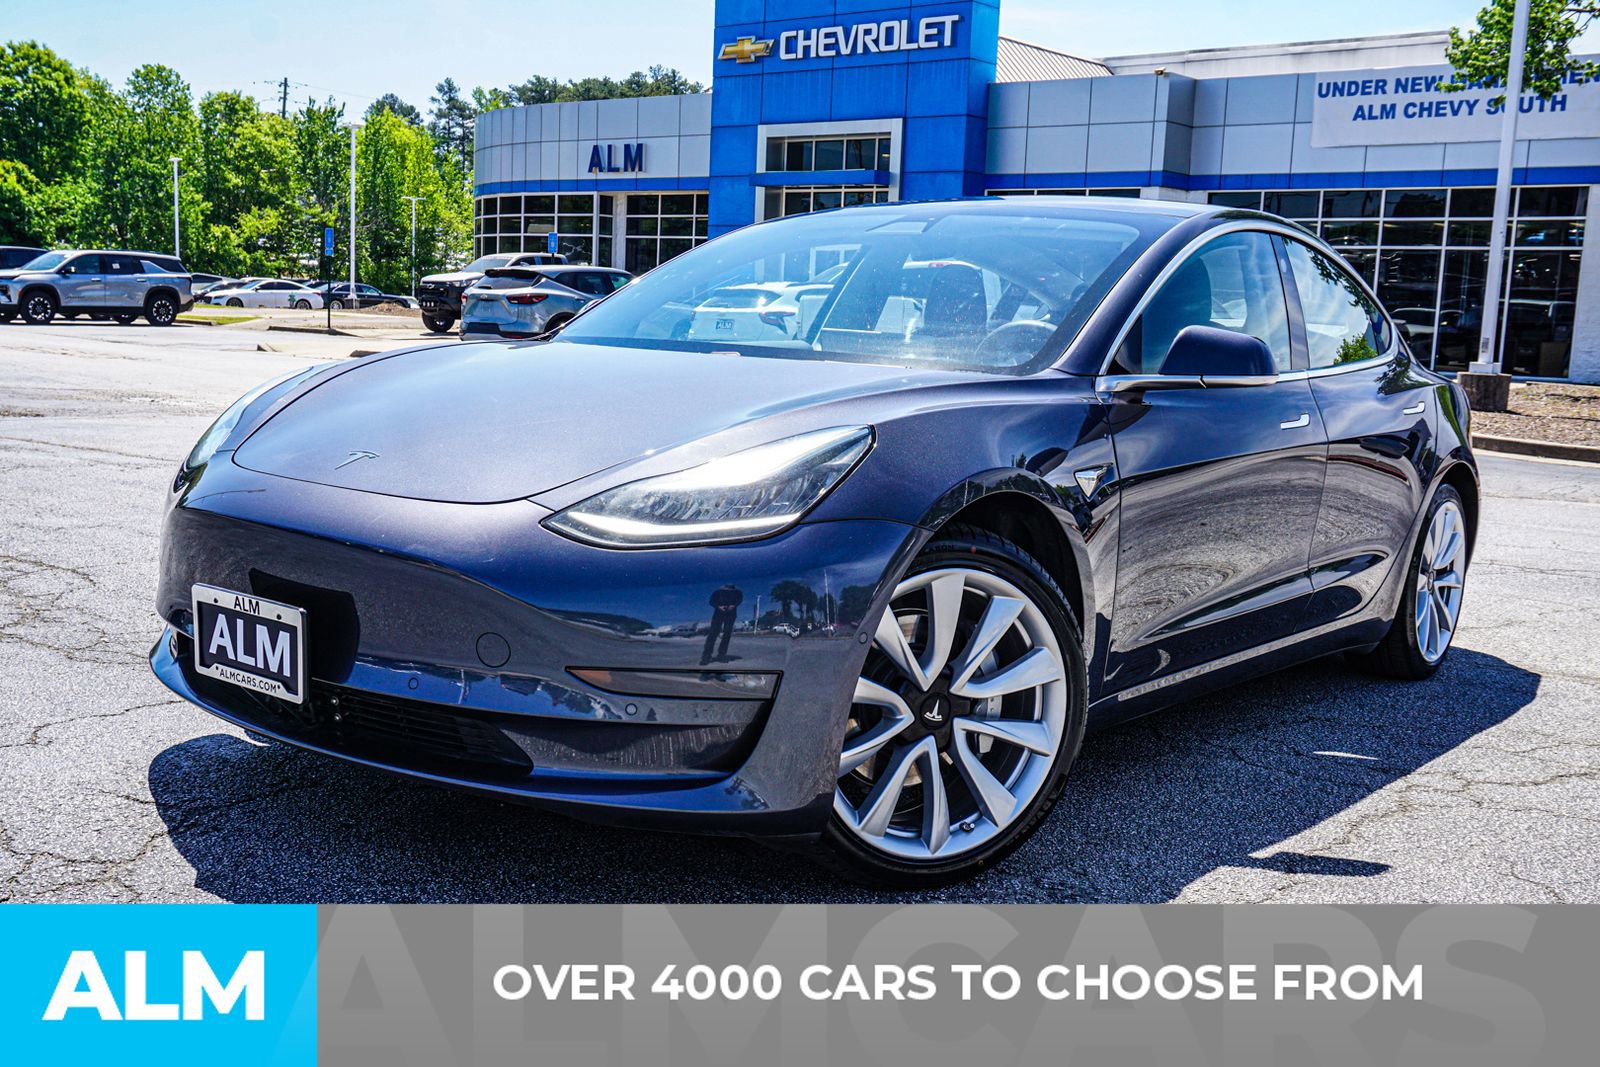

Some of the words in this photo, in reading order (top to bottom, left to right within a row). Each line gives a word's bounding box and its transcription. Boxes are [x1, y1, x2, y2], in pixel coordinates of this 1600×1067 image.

[780, 15, 960, 60] CHEVROLET
[1317, 79, 1388, 98] UNDER
[1394, 75, 1444, 95] NEW
[1352, 103, 1396, 121] ALM
[1403, 98, 1480, 119] CHEVY
[1485, 95, 1567, 116] SUTH
[587, 143, 645, 173] ALM
[233, 595, 261, 616] ALM
[208, 613, 291, 678] ALM
